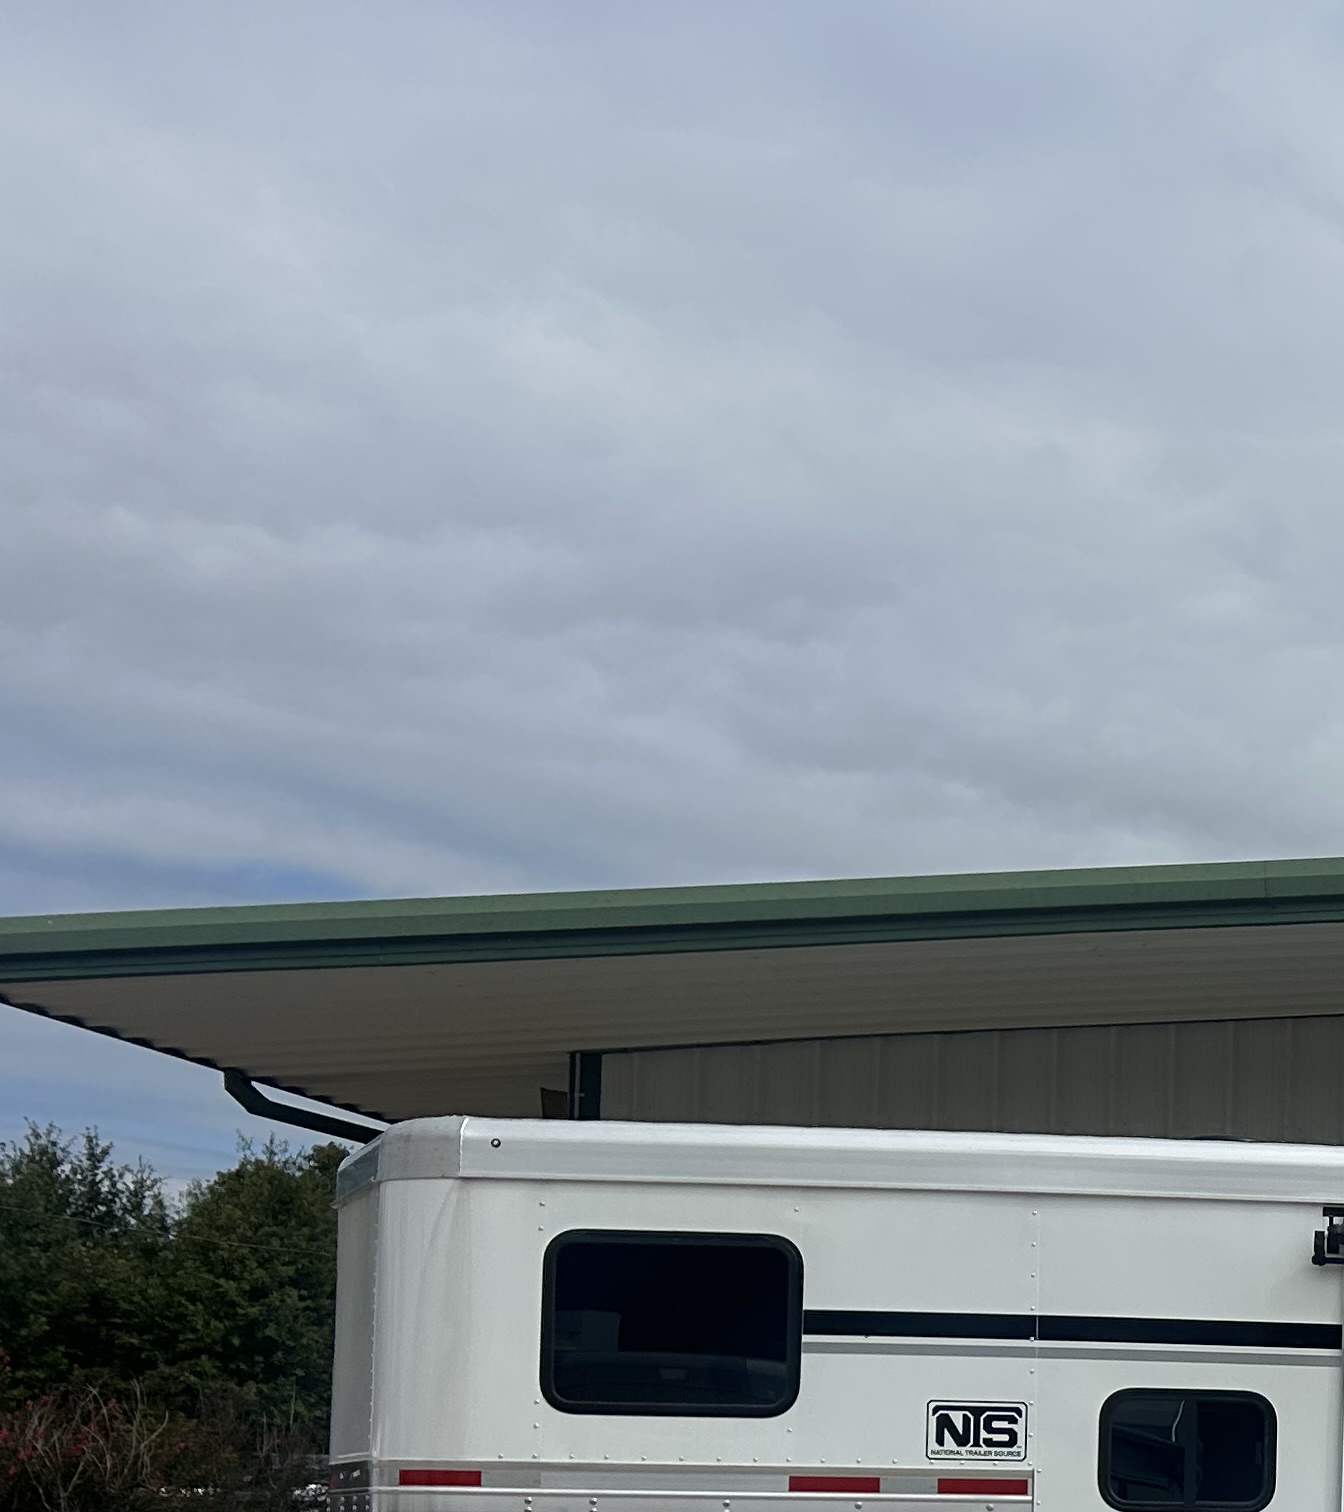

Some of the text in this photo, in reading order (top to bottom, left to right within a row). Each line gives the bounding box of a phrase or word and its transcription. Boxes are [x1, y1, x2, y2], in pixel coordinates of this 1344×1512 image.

[931, 1405, 1023, 1448] NTS
[930, 1449, 1022, 1458] NATIONAL TRAILER SOURCE
